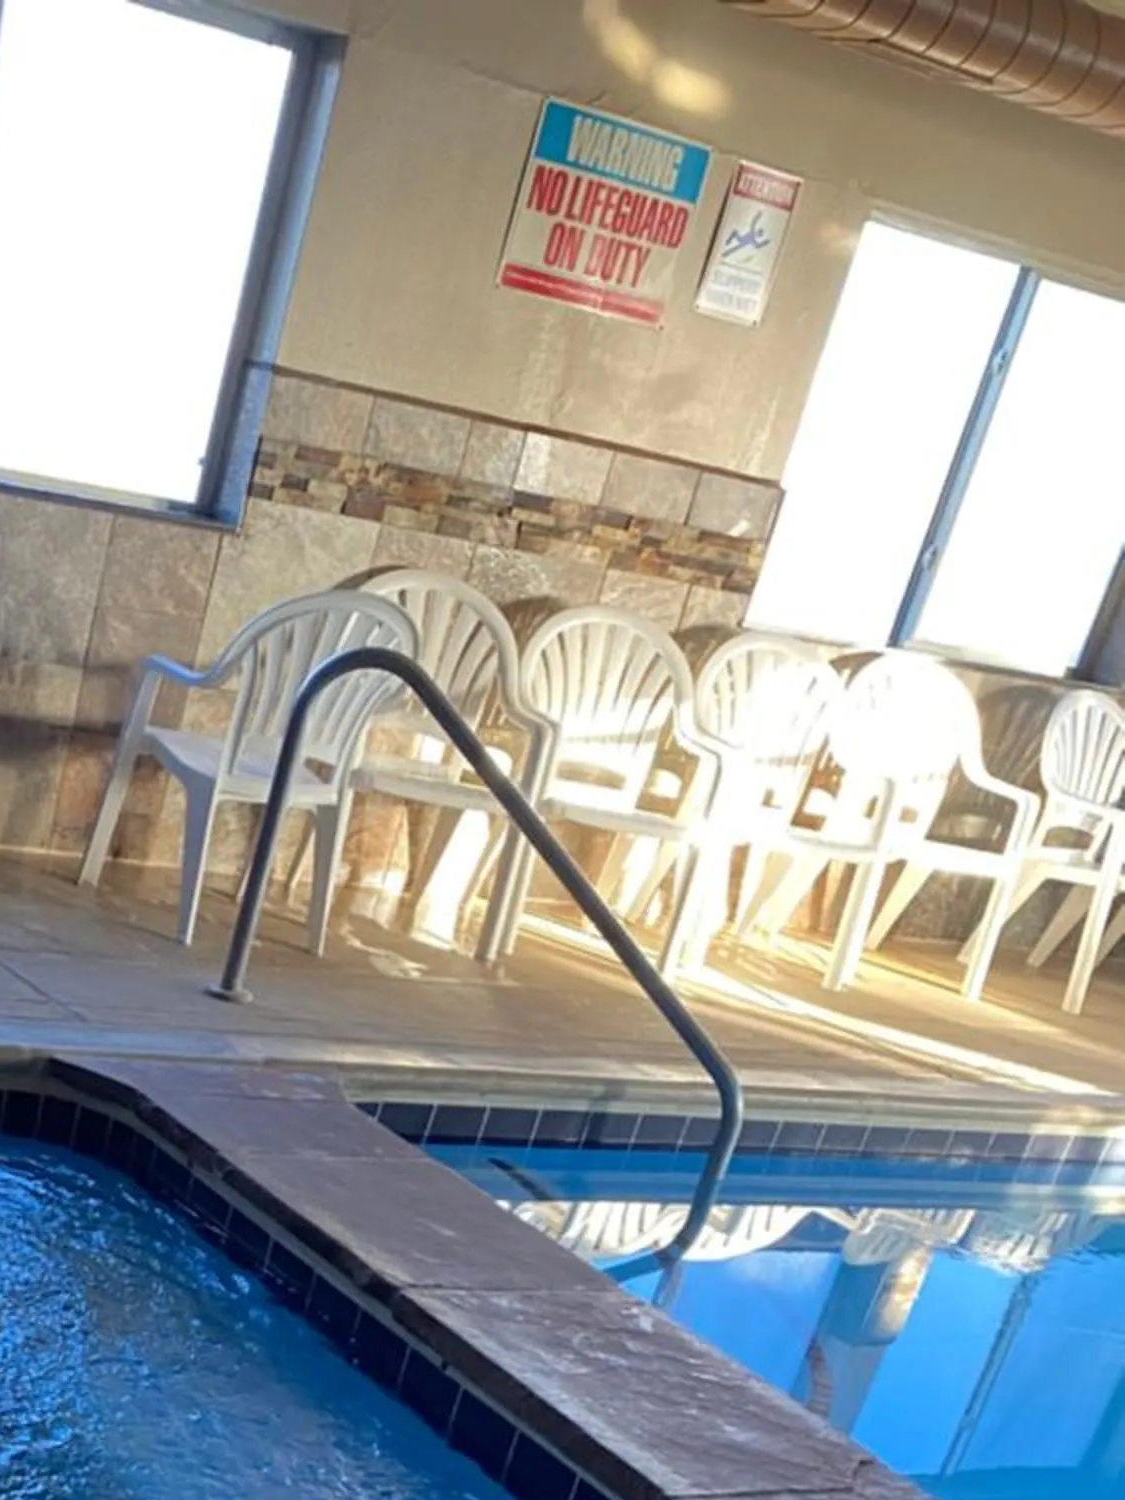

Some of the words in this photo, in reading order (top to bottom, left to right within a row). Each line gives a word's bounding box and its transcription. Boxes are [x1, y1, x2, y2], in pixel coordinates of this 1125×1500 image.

[566, 114, 684, 193] WARNING
[526, 166, 566, 216] NO
[564, 176, 690, 249] LIFEGUARD
[543, 223, 579, 272] ON
[583, 232, 651, 288] DUTY
